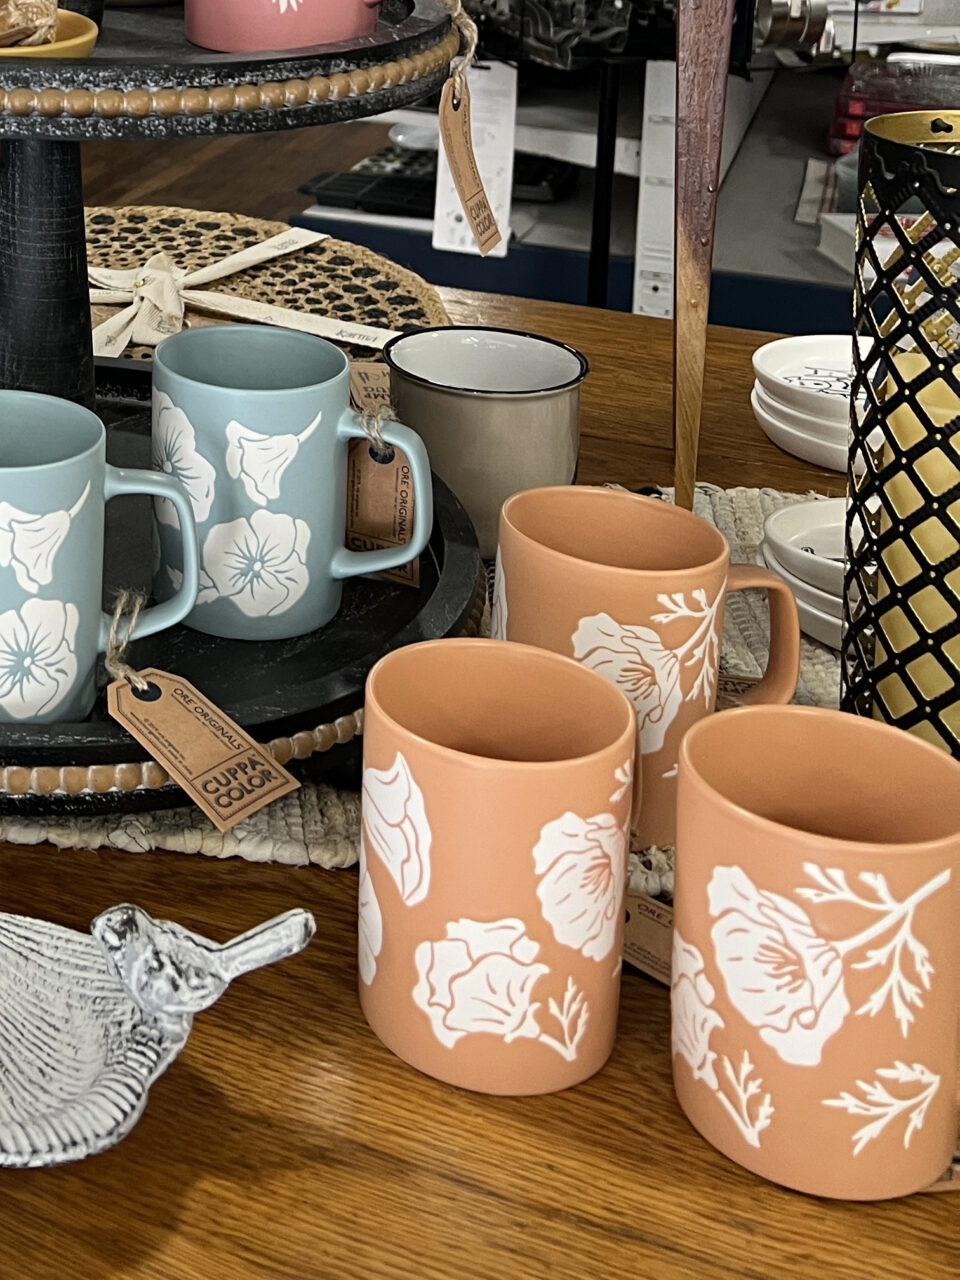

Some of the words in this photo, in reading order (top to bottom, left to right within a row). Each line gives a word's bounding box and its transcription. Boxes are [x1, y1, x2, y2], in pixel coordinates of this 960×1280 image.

[469, 200, 488, 221] CUPPA
[401, 465, 410, 486] ORE
[398, 489, 409, 543] ORIGINALS
[173, 687, 194, 706] ORE
[194, 705, 244, 750] ORIGINALS
[202, 756, 264, 795] CUPPA
[214, 767, 278, 809] COLOR
